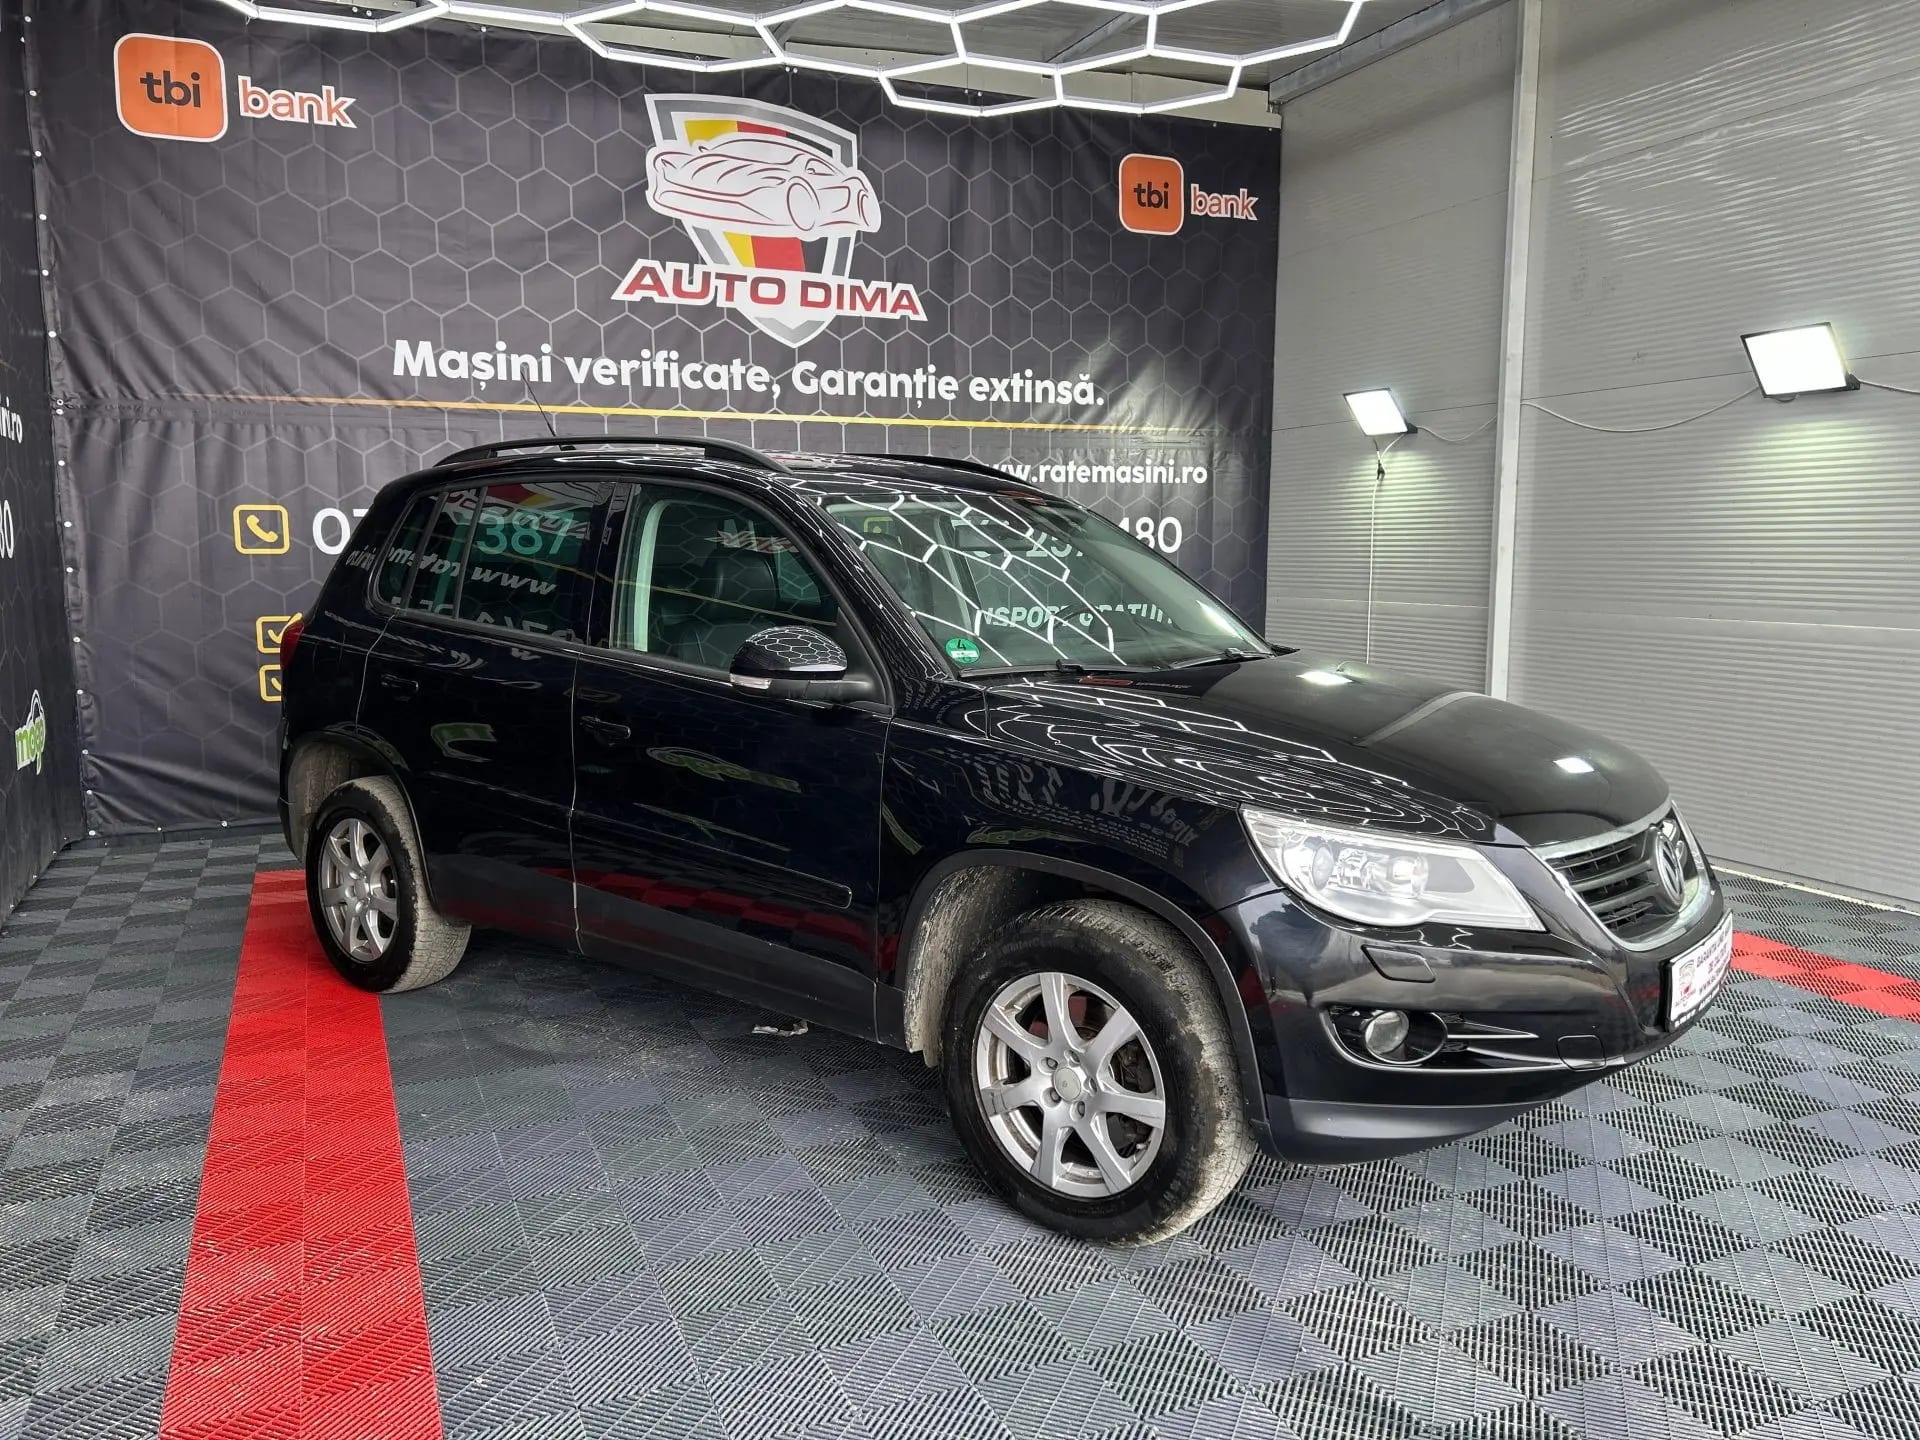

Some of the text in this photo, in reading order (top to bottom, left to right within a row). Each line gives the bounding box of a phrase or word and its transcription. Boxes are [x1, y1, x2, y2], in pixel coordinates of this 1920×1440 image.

[139, 70, 355, 127] tbi bank
[1133, 181, 1258, 220] tbi bank
[619, 264, 922, 316] AUTO DIMA
[392, 339, 1105, 408] Mașini verificate, Garanție extinsă.
[984, 458, 1208, 484] w.ratemasini.ro
